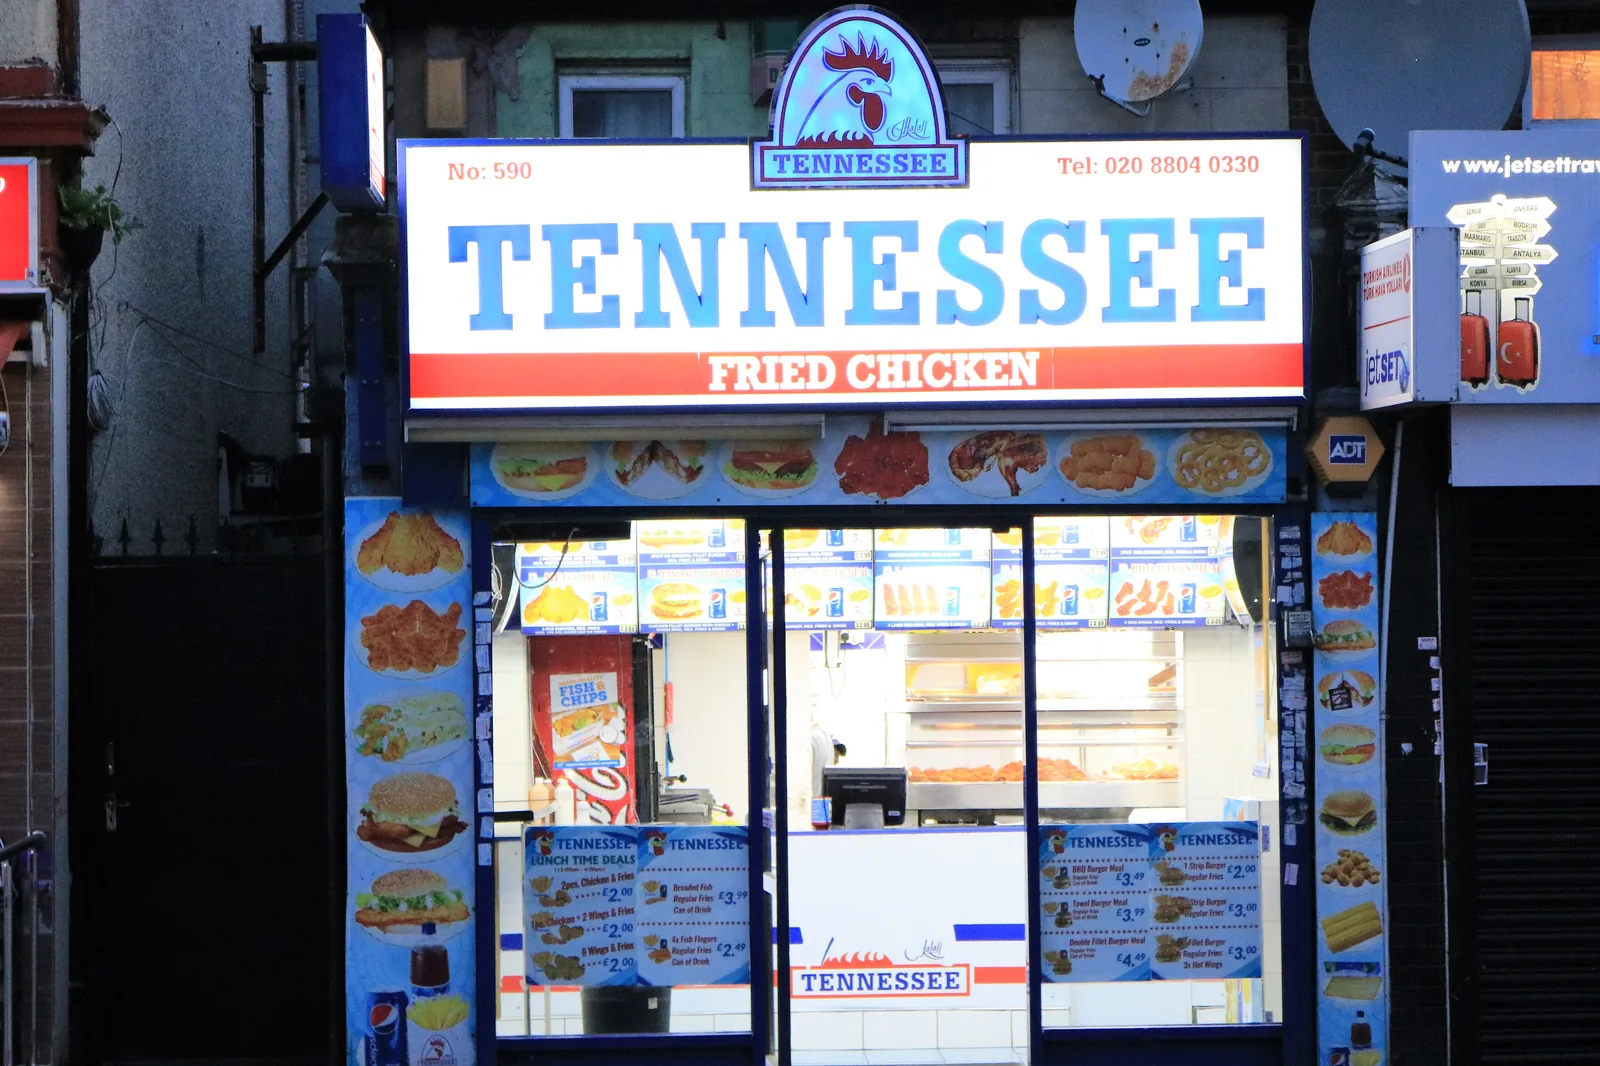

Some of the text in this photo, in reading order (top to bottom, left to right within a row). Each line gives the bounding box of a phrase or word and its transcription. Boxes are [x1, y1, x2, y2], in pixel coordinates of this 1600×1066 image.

[773, 153, 947, 174] TENNESSEE
[1057, 156, 1259, 174] Tel: 020 8804 0330
[448, 162, 532, 180] No: 590
[1513, 221, 1538, 229] BODRUM
[1464, 233, 1491, 242] MARMARIS
[1513, 250, 1542, 258] ANTALYA
[448, 217, 1265, 330] TENNESSEE
[1363, 261, 1402, 286] TURKISH AIRLINES
[1512, 279, 1527, 287] BURSA
[708, 351, 1040, 391] FRIED CHICKEN
[1364, 349, 1401, 397] jetSET
[1330, 441, 1366, 459] ADT
[559, 681, 595, 697] FISH
[596, 681, 605, 691] &
[561, 691, 607, 707] CHIPS
[556, 838, 631, 850] TENNESSEE
[669, 838, 744, 850] TENNESSEE
[1069, 836, 1143, 848] TENNESSEE
[1180, 834, 1252, 846] TENNESSEE
[531, 855, 636, 865] LUNCH TIME DEALS
[1072, 866, 1086, 874] BBQ
[1087, 865, 1108, 873] Burger
[1189, 862, 1204, 870] Strip
[1205, 861, 1227, 870] Burger
[581, 876, 609, 887] Chicken
[611, 874, 616, 882] &
[618, 872, 635, 882] Fries
[1184, 872, 1224, 882] Regular Fries
[673, 883, 713, 892] Breaded Fish
[673, 895, 714, 904] Regular Fries
[1091, 899, 1112, 908] Burger
[1113, 898, 1128, 906] Meal
[1190, 898, 1227, 907] Strip Burger
[582, 913, 587, 921] 2
[589, 911, 609, 921] Wings
[611, 908, 617, 916] &
[618, 907, 635, 915] Fries
[673, 906, 686, 914] Can
[694, 905, 712, 913] Drink
[694, 936, 717, 944] Fingers
[1069, 938, 1090, 946] Double
[1091, 938, 1107, 946] Fillet
[1108, 937, 1129, 946] Burger
[1205, 939, 1226, 947] Burger
[582, 942, 635, 957] 6 Wings & Fries
[671, 947, 695, 955] Regular
[1183, 949, 1223, 958] Regular Fries
[671, 958, 684, 966] Can
[685, 958, 692, 966] of
[1205, 961, 1223, 969] Wings
[801, 971, 960, 991] TENNESSEE
